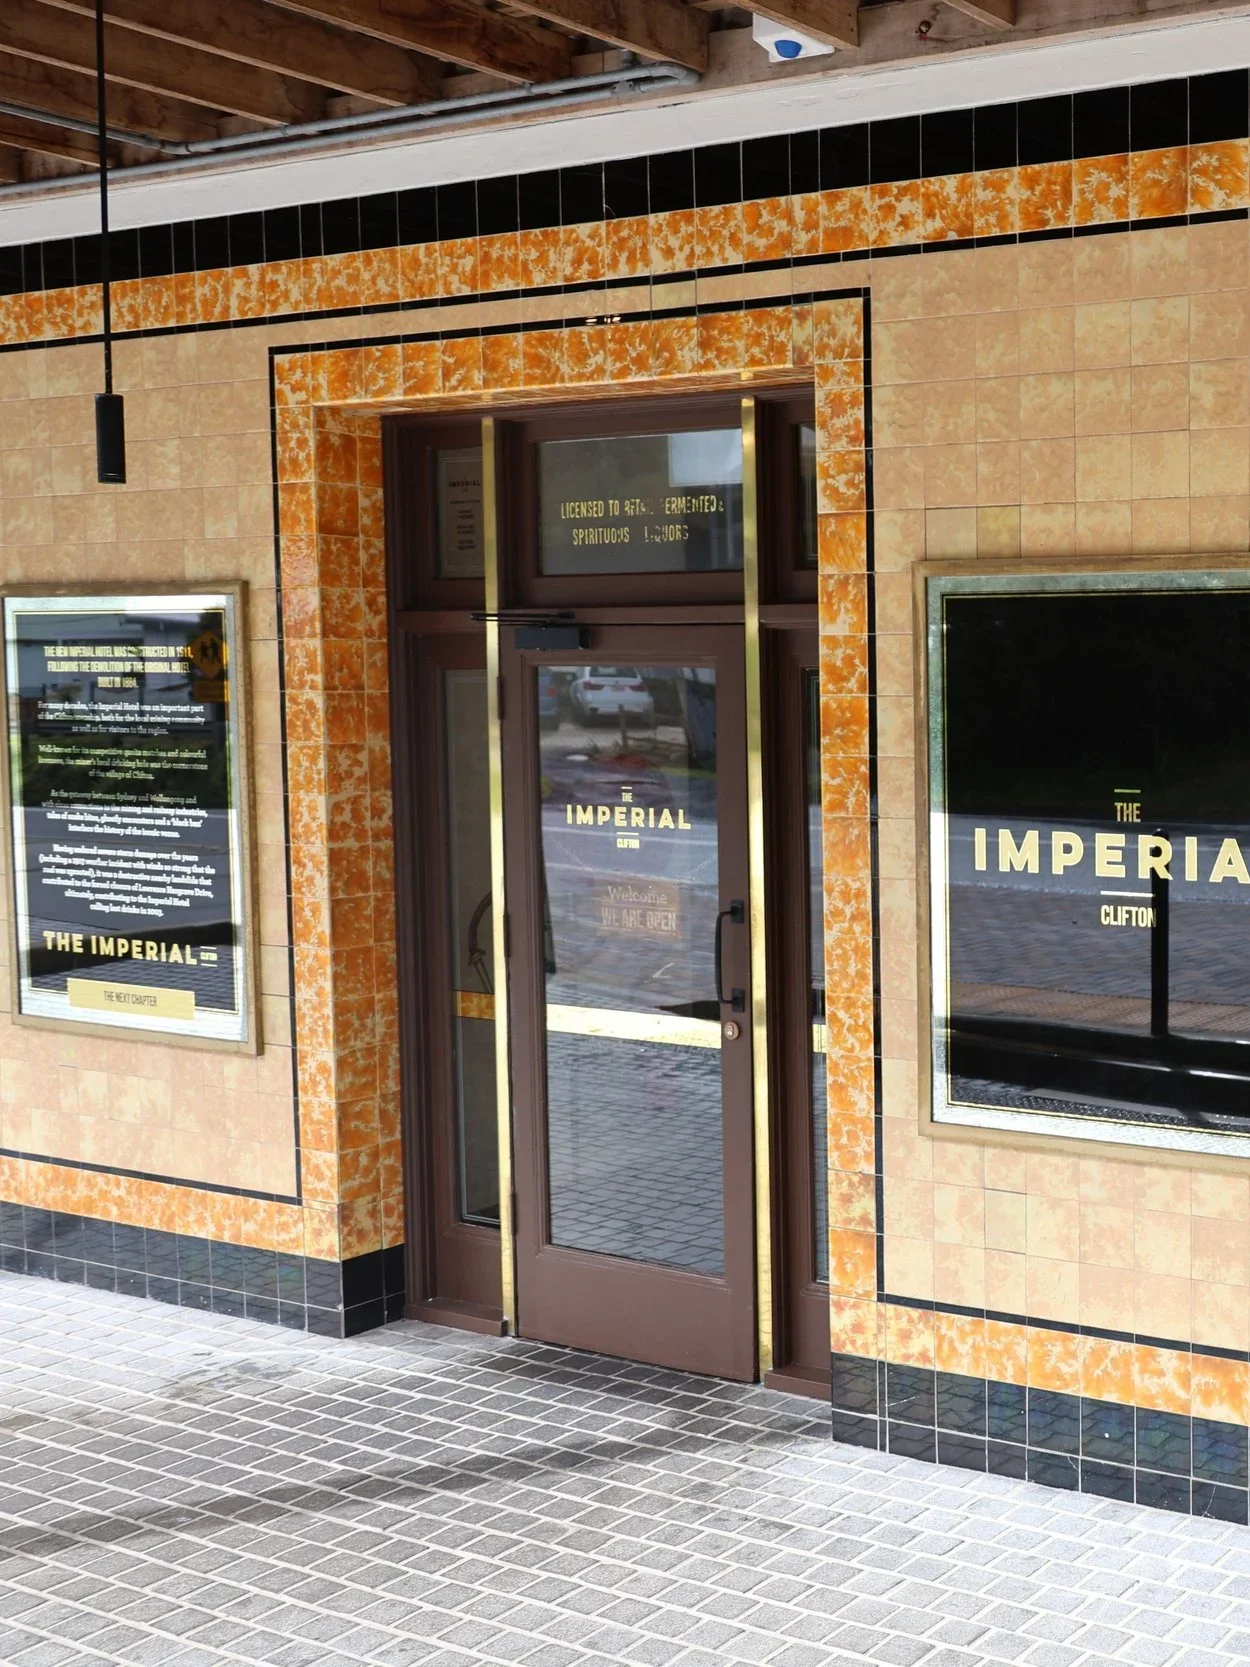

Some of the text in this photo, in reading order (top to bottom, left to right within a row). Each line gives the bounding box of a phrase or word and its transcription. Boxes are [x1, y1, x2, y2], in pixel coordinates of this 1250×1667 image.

[561, 501, 604, 519] LICENSED
[609, 500, 620, 516] TO
[624, 499, 653, 517] RETA
[660, 495, 716, 514] ERMENTED
[572, 525, 689, 546] SPIRITUOUS LQUORS
[622, 792, 633, 803] THE
[566, 804, 692, 830] IMPERIAL
[1114, 802, 1141, 823] THE
[606, 886, 668, 905] Welcome
[601, 907, 677, 931] WE ARE OPEN
[1100, 904, 1157, 928] CLIFTON
[43, 931, 198, 965] THE IMPERIAL
[104, 990, 158, 1007] THE NEXT CHAPTER
